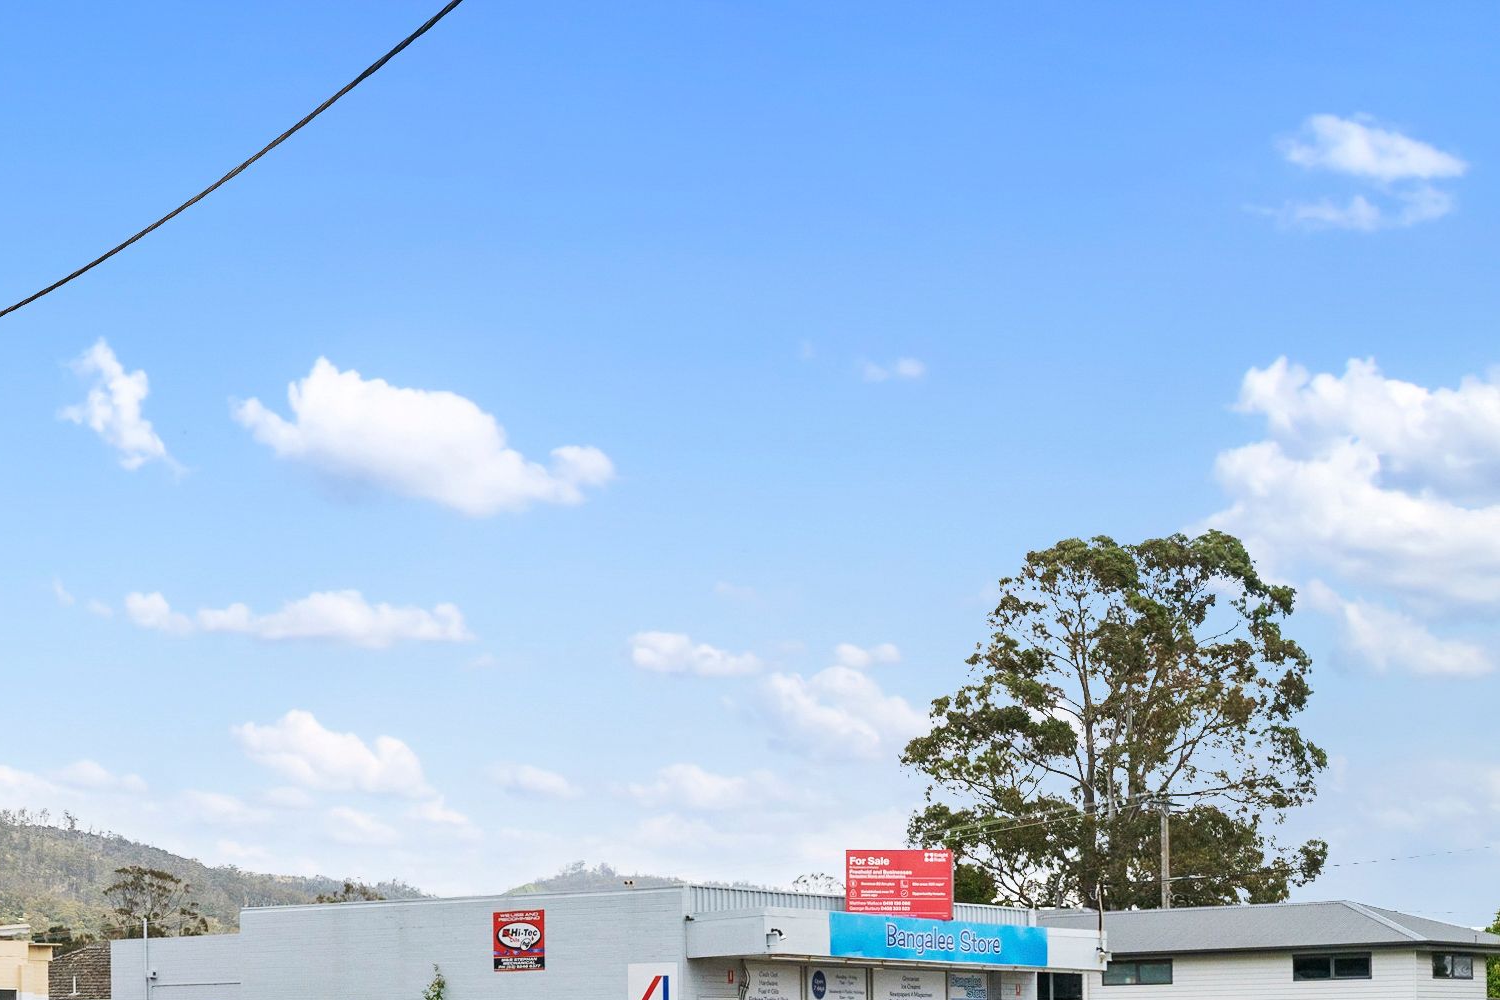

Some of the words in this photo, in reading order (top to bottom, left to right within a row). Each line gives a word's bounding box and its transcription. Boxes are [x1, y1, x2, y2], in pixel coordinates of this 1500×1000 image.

[849, 856, 867, 866] For
[867, 856, 890, 866] Sale
[886, 924, 954, 955] Bangalee
[960, 930, 1001, 954] Store
